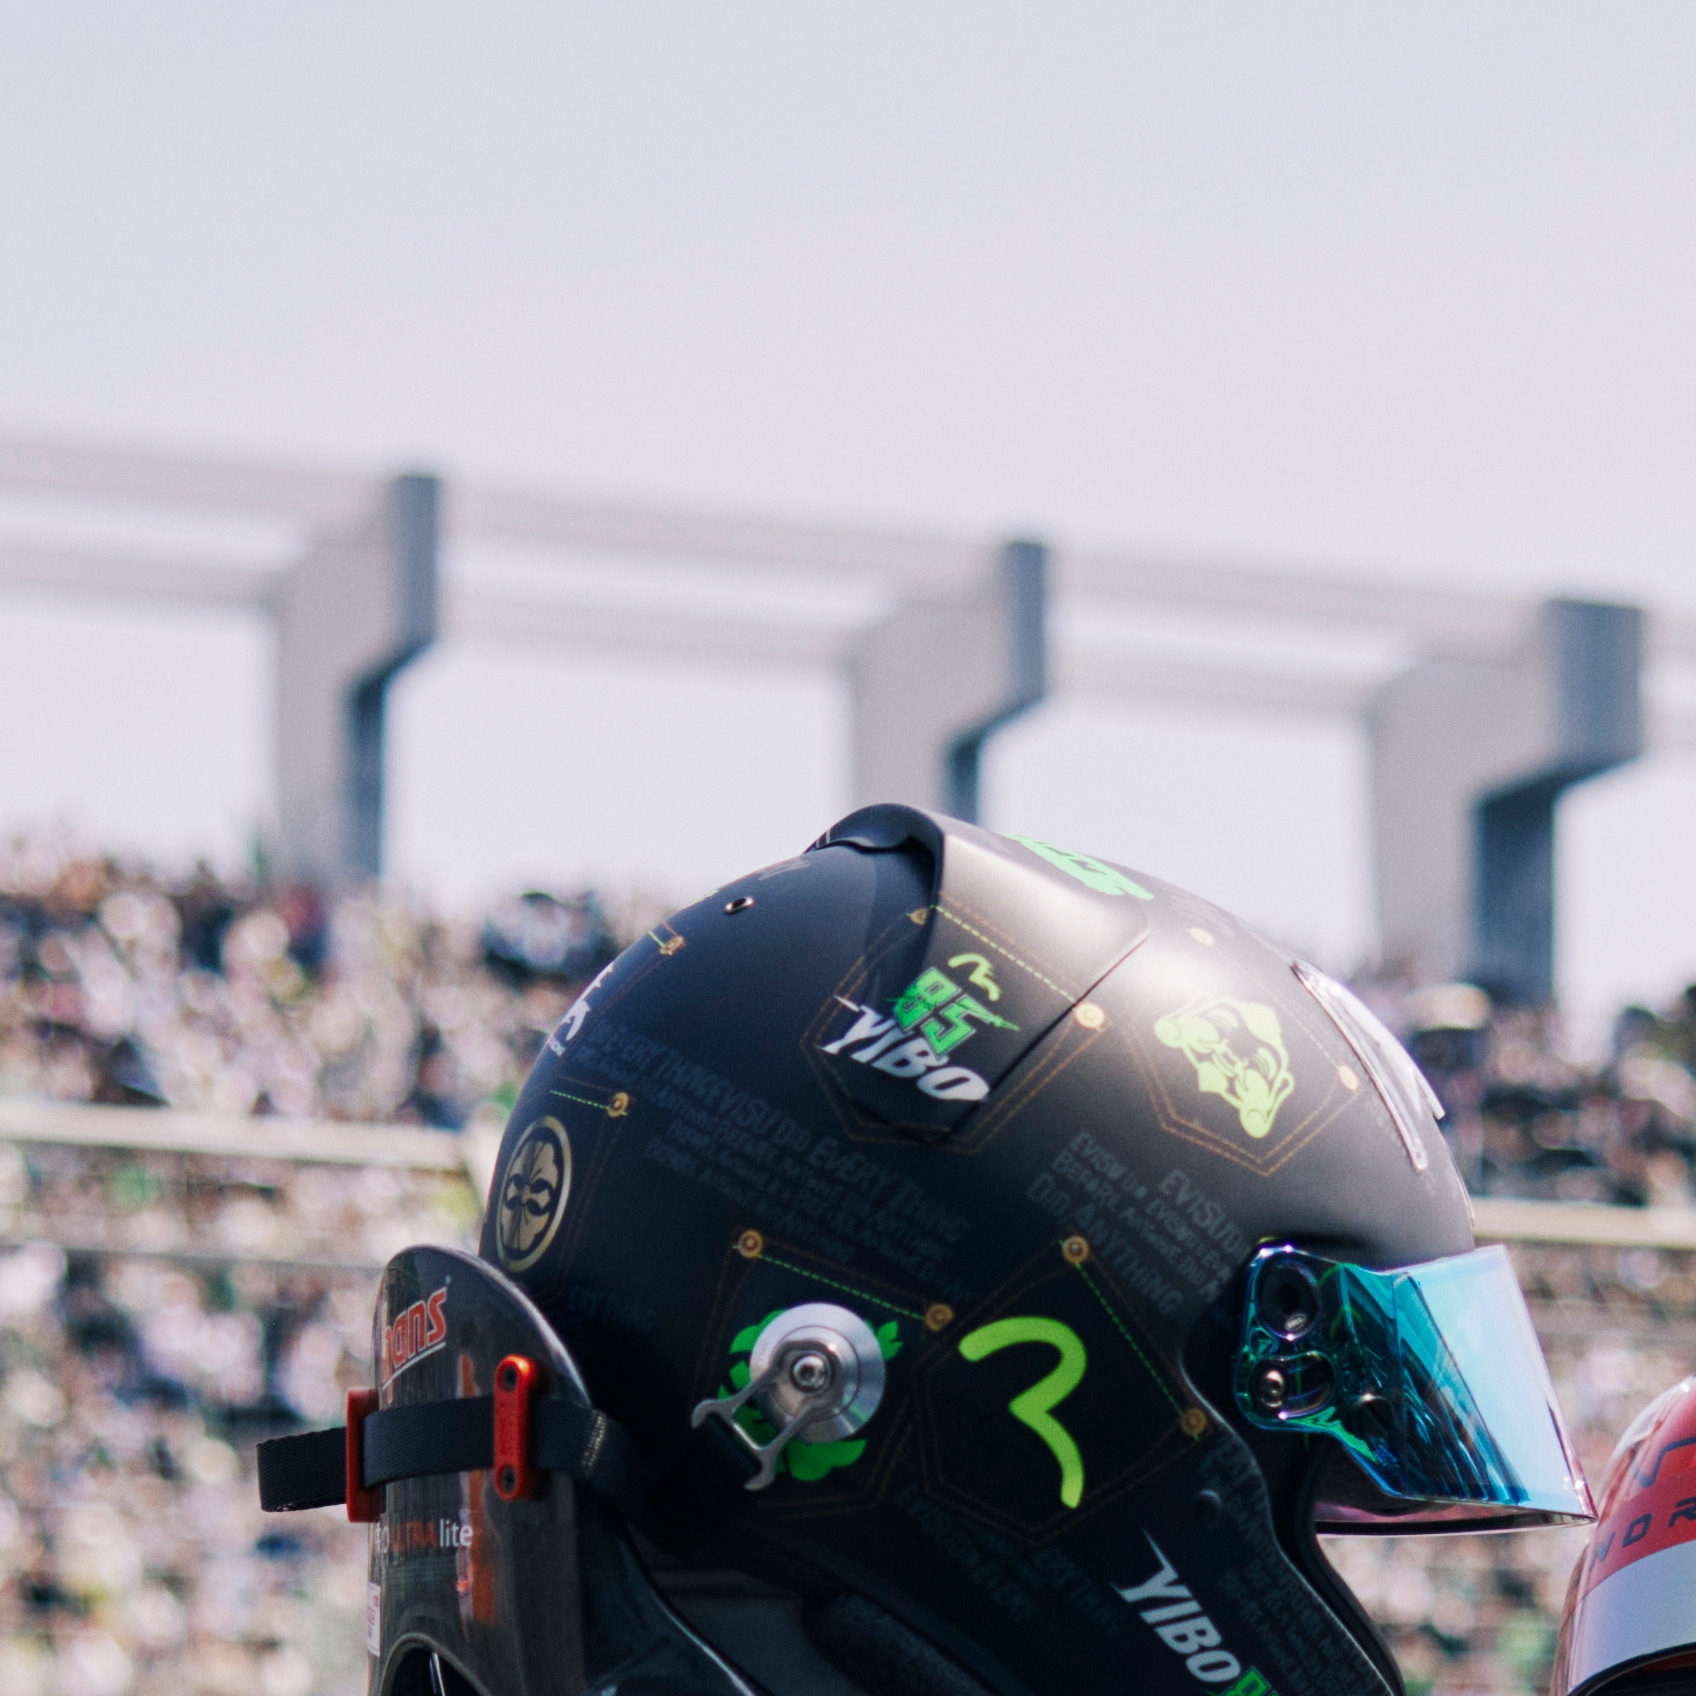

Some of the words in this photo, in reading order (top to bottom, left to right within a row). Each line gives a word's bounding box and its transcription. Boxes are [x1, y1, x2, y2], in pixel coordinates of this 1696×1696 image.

[816, 995, 990, 1101] YIBO
[439, 1518, 473, 1547] lite
[1110, 1528, 1241, 1682] YIBO
